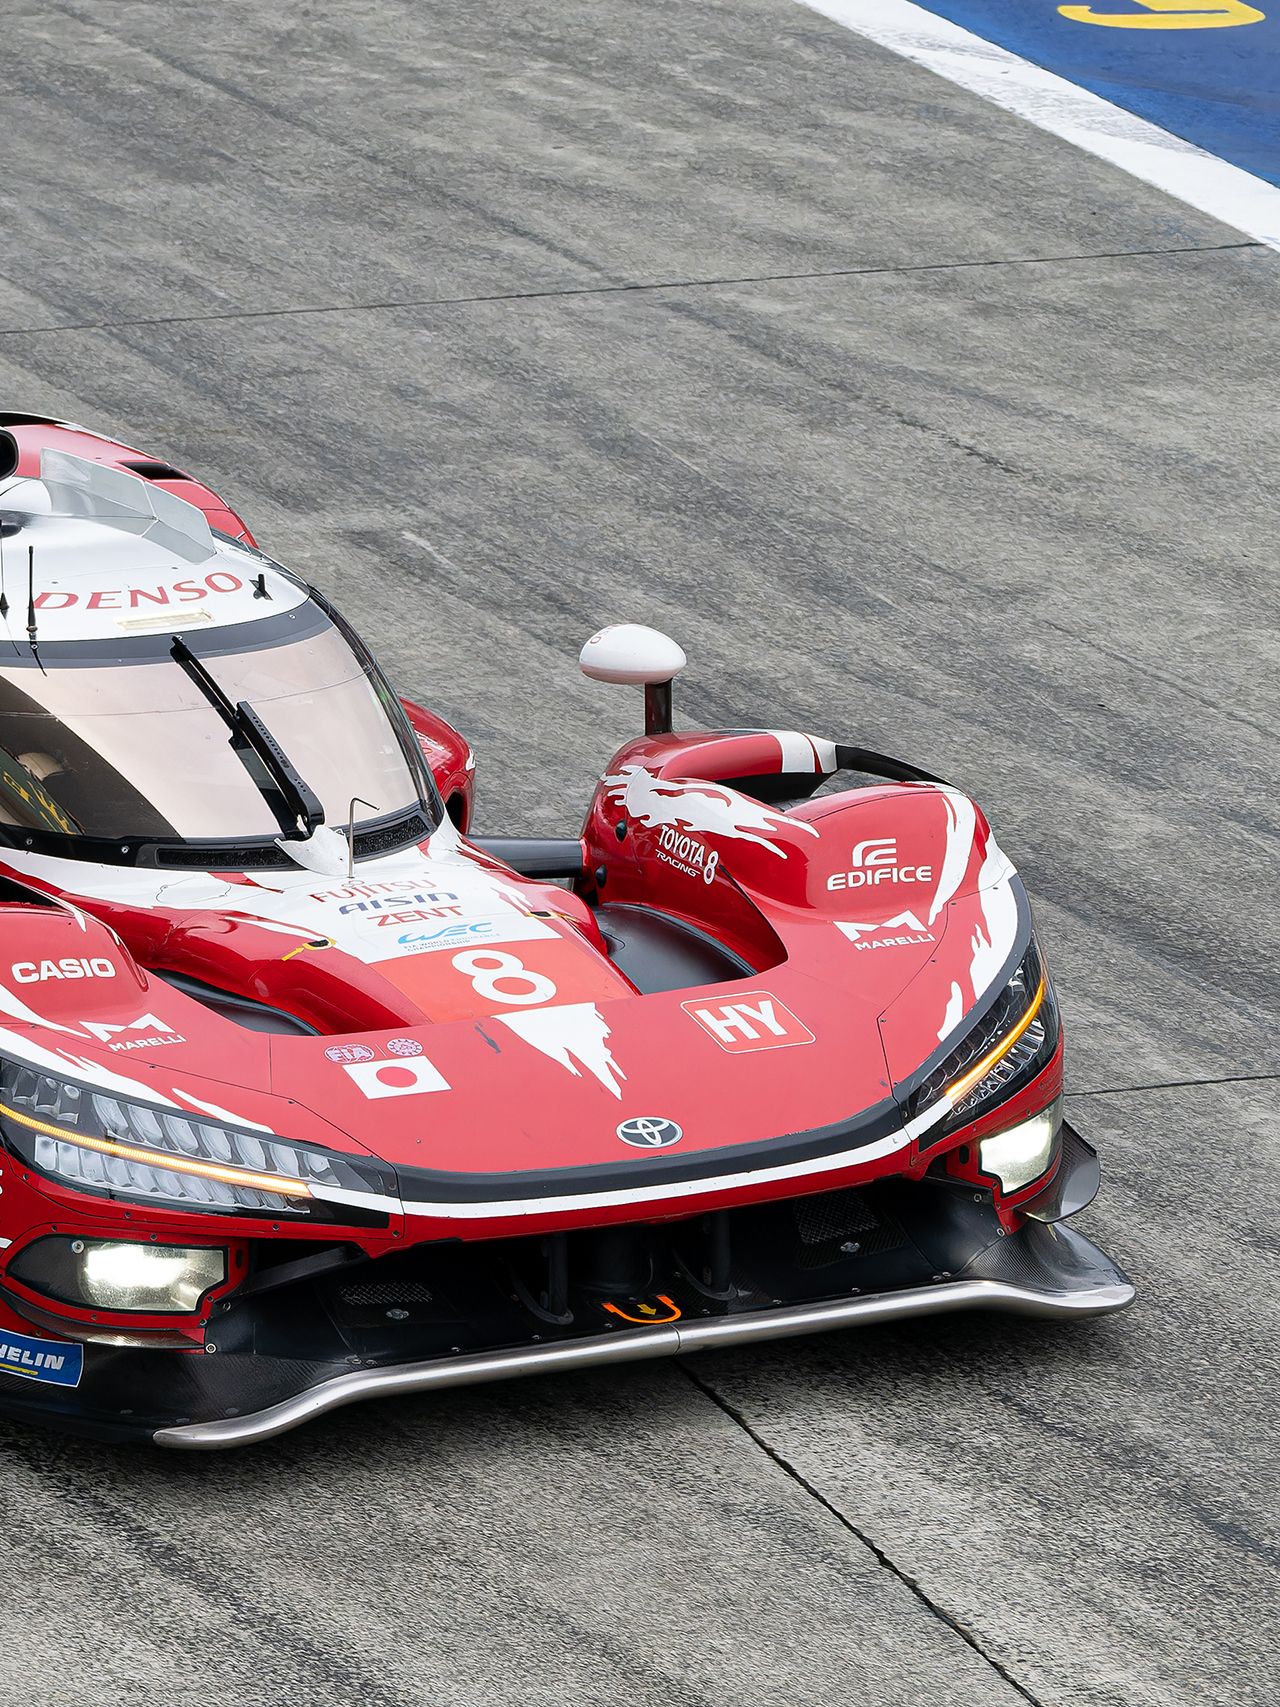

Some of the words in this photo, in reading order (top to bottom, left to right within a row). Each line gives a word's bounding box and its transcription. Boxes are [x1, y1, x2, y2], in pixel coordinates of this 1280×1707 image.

[33, 571, 243, 610] DENSO
[655, 849, 701, 878] RACING
[656, 823, 705, 867] TOYOTA
[703, 850, 719, 885] 8
[827, 865, 932, 891] EDIFICE
[308, 879, 438, 903] FUJITSU
[338, 891, 459, 916] AISIN
[366, 905, 464, 928] ZENT
[397, 921, 494, 945] WEC
[854, 932, 936, 952] MARELLI
[11, 957, 116, 984] CASIO
[451, 948, 557, 1006] 8
[695, 999, 789, 1043] HY
[108, 1034, 187, 1052] MARELLI
[325, 1046, 372, 1062] FIA
